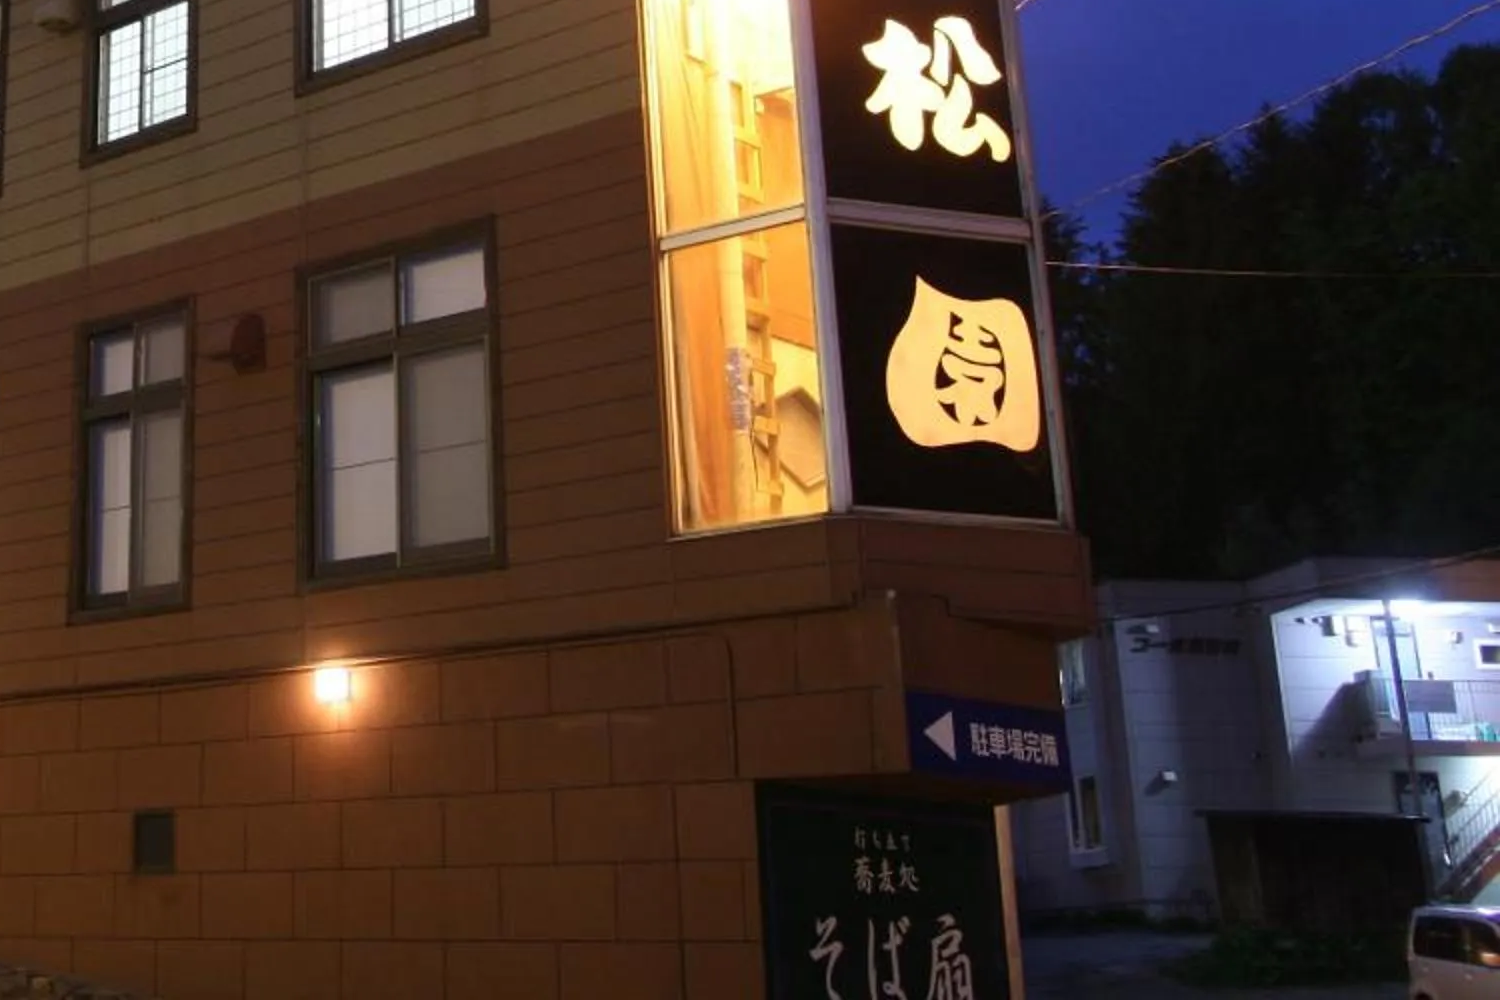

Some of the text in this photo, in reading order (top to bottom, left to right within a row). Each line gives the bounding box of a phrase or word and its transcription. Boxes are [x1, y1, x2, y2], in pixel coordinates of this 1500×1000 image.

[969, 722, 1059, 767] 駐車場完備
[854, 856, 920, 894] 蕎麦処
[808, 912, 974, 1000] そば扇
